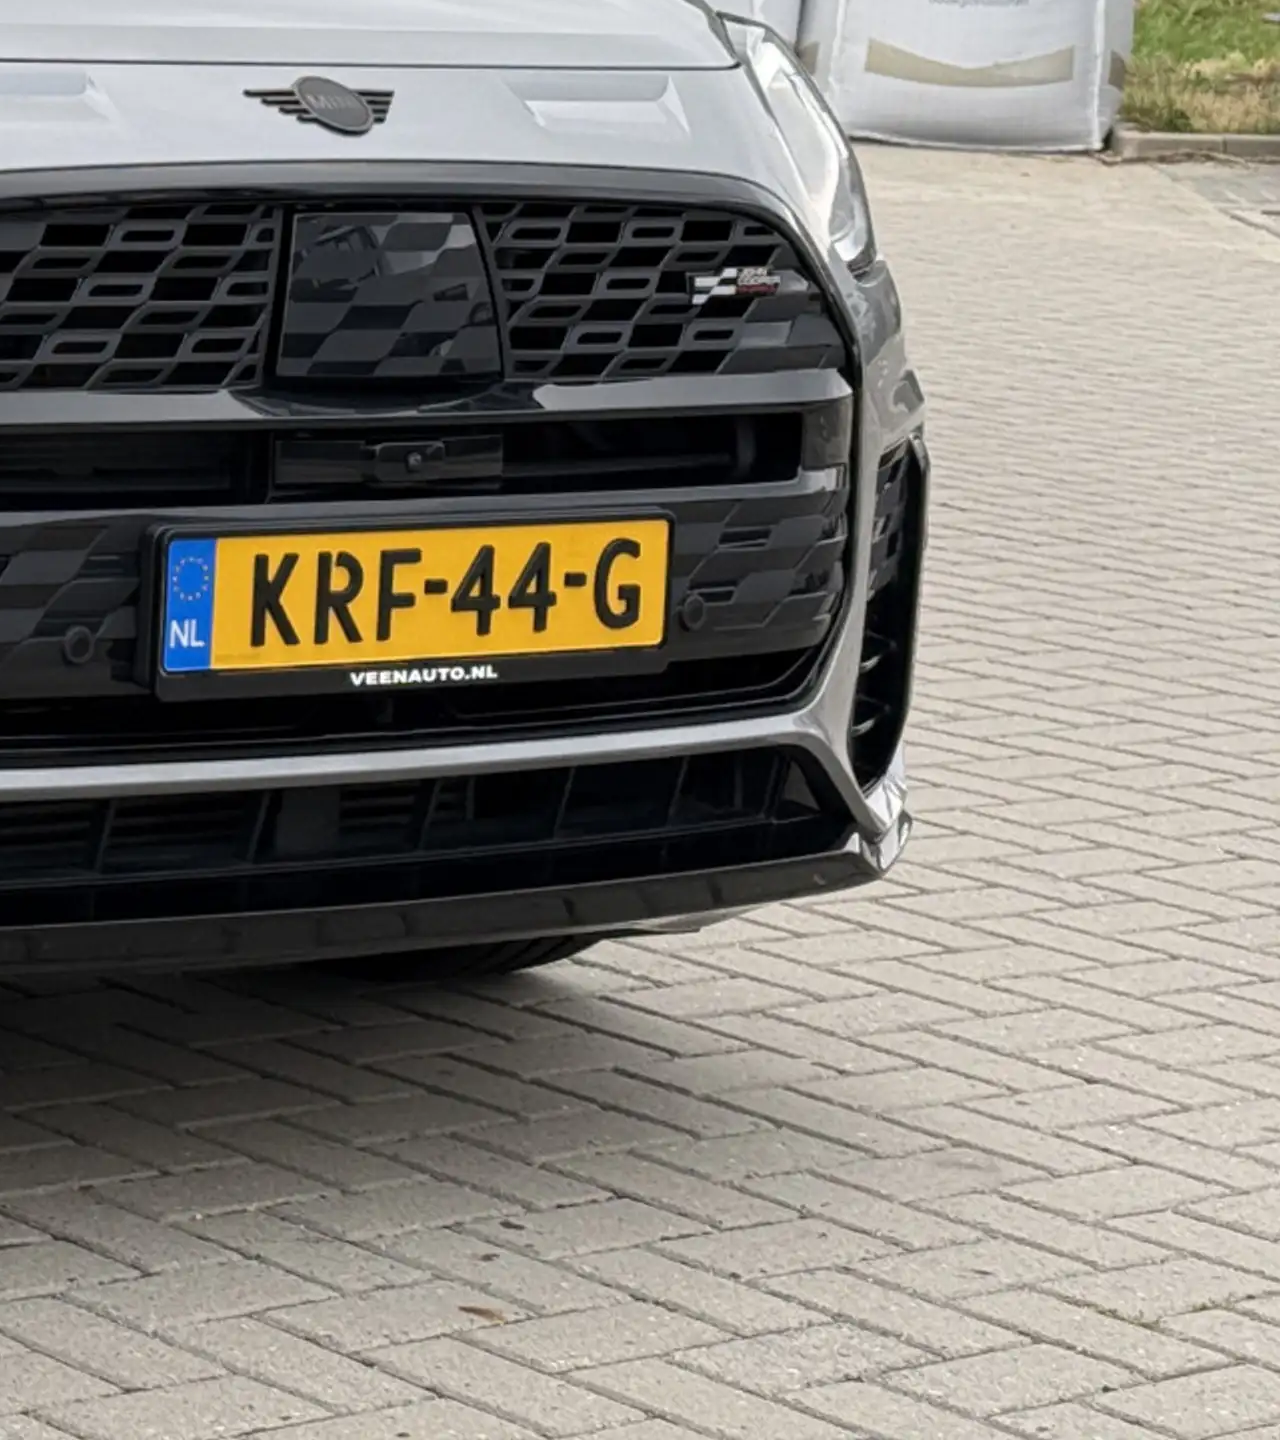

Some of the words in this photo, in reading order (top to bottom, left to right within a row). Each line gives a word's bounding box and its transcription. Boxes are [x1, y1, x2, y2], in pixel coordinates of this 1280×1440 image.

[169, 620, 205, 648] NL
[249, 537, 641, 647] KRF-44-G
[349, 664, 498, 687] VEENAUTO.NL
